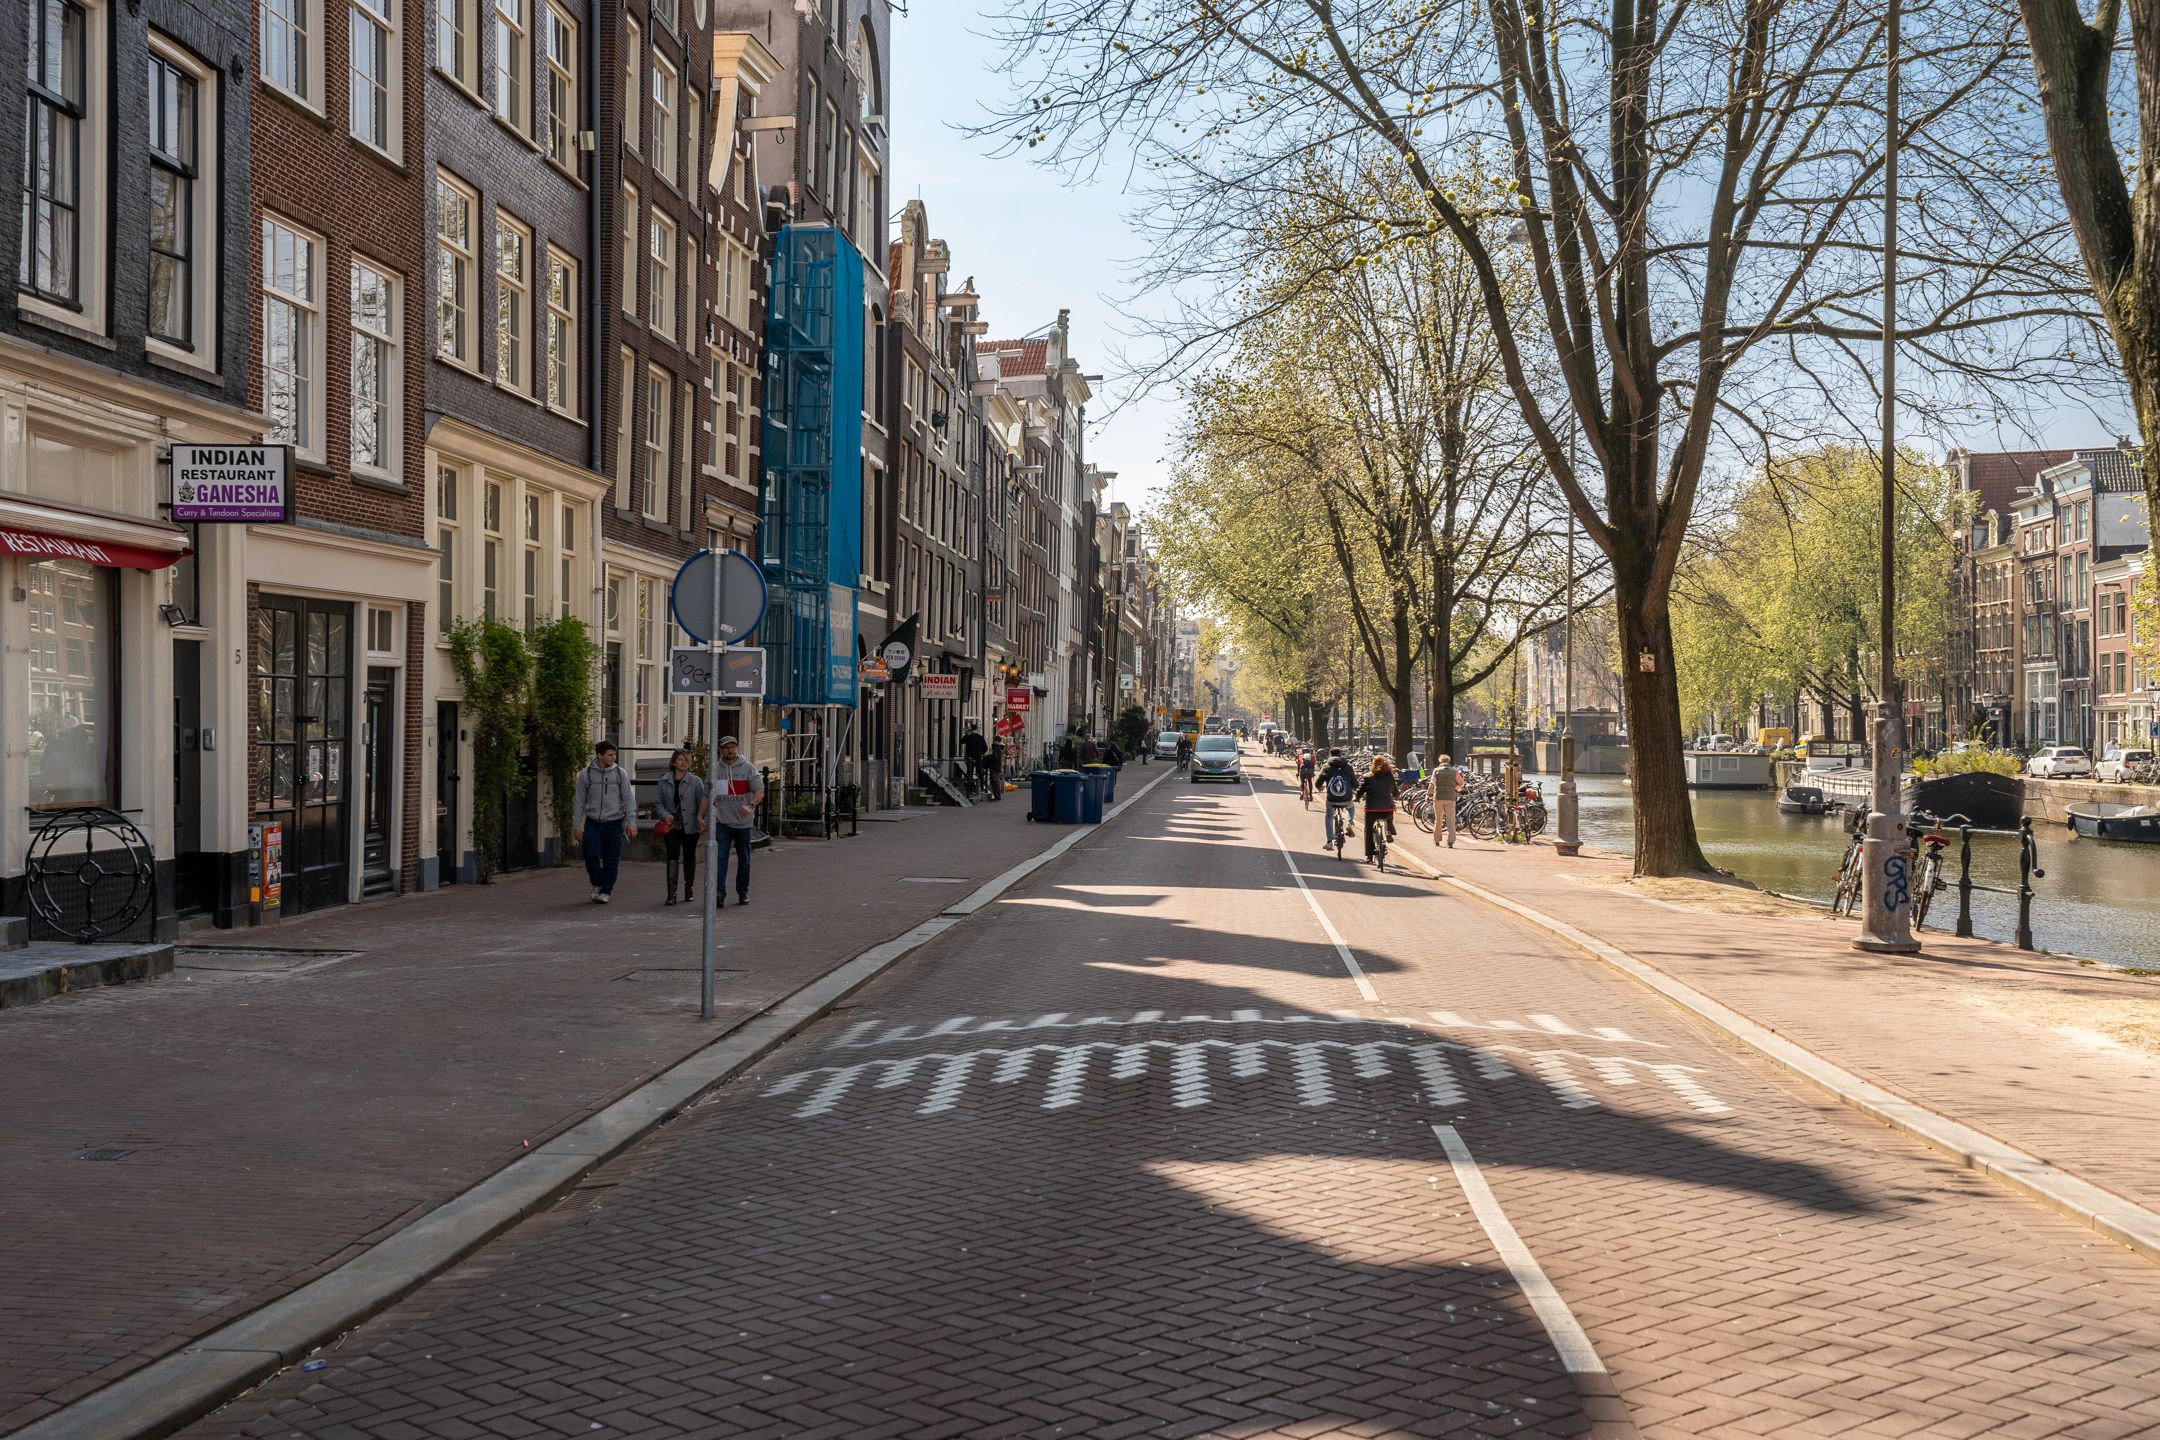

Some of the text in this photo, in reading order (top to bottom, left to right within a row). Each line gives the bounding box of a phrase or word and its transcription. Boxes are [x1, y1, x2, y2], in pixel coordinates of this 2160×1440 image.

[191, 450, 265, 465] INDIAN
[181, 469, 276, 480] RESTAURANT
[197, 484, 280, 503] GANESHA
[177, 507, 280, 518] Curry & Tandoori Specialities
[0, 531, 112, 563] RESTAURANT
[235, 649, 241, 664] 5
[924, 676, 956, 684] INDIAN
